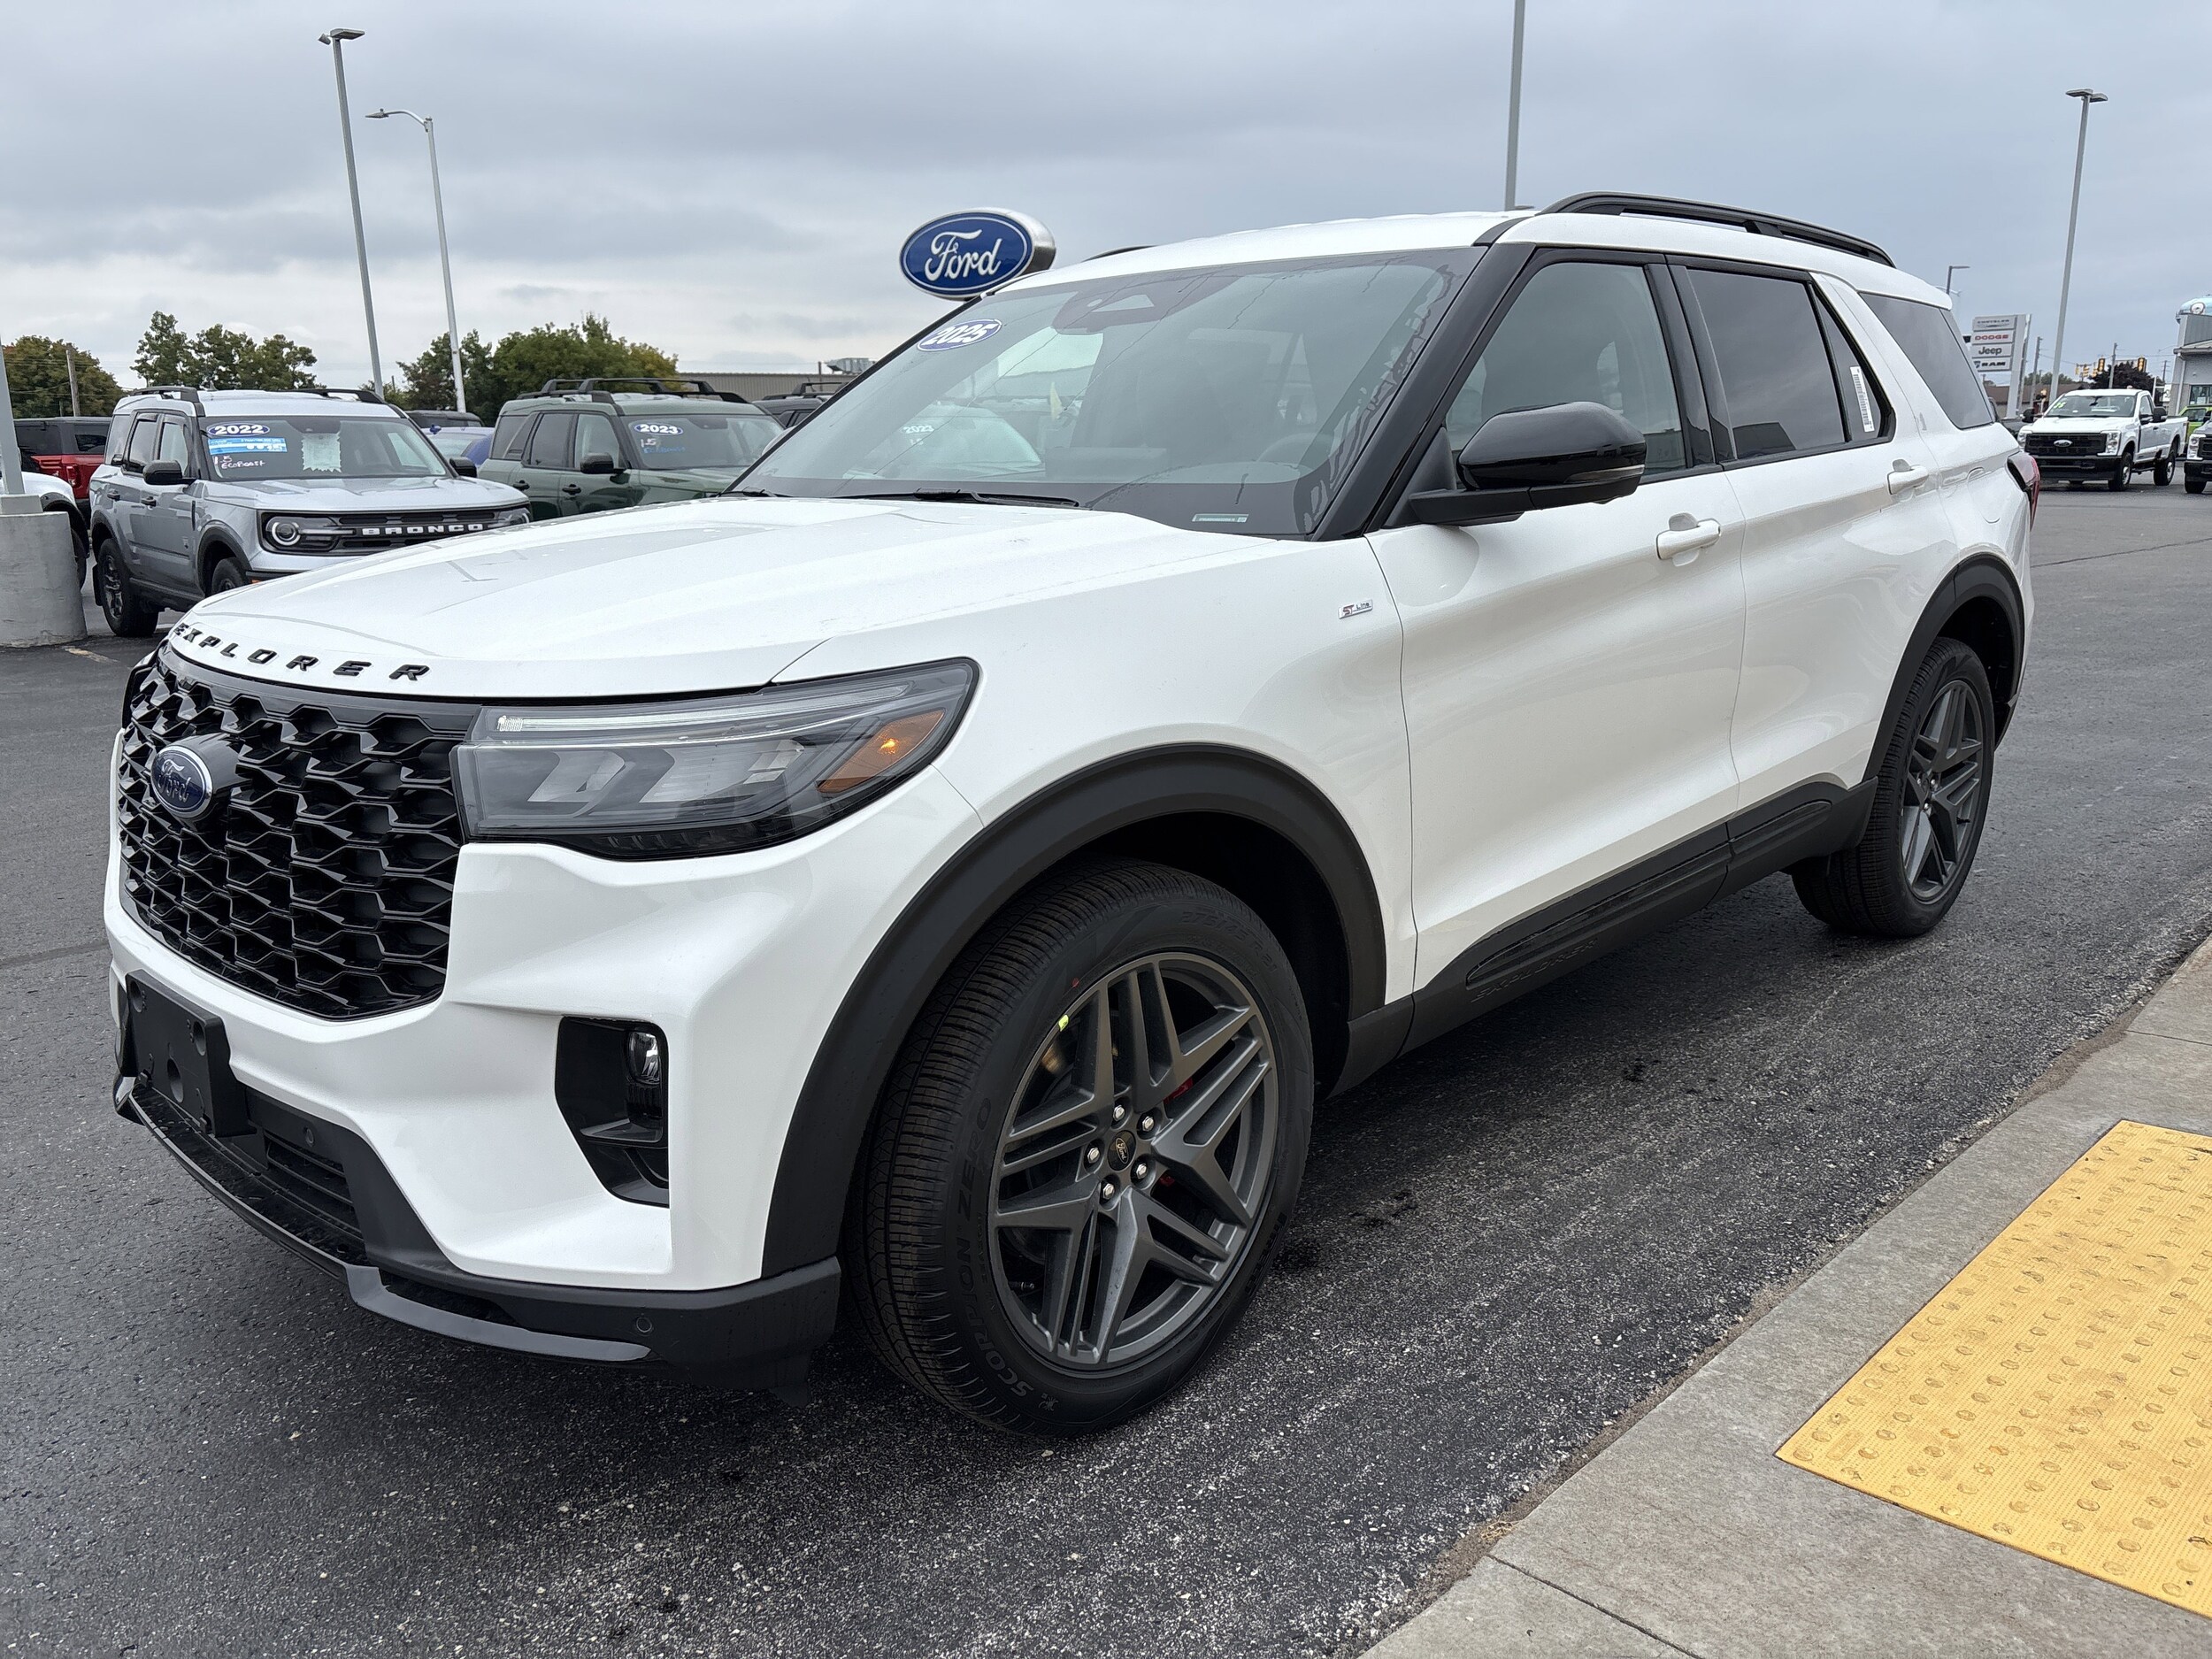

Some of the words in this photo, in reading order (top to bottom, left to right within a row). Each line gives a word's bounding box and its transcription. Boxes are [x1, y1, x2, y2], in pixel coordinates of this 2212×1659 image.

[925, 229, 1002, 281] Ford
[920, 322, 1000, 345] 2025
[1978, 346, 2002, 356] Jeep
[214, 424, 265, 435] 2022
[640, 424, 679, 434] 2023
[362, 524, 483, 535] BRONCO
[1342, 604, 1355, 616] ST
[173, 622, 431, 681] EXPLORER
[157, 759, 192, 803] Ford
[956, 1097, 993, 1222] ZERO
[956, 1235, 1034, 1397] SCORPION
